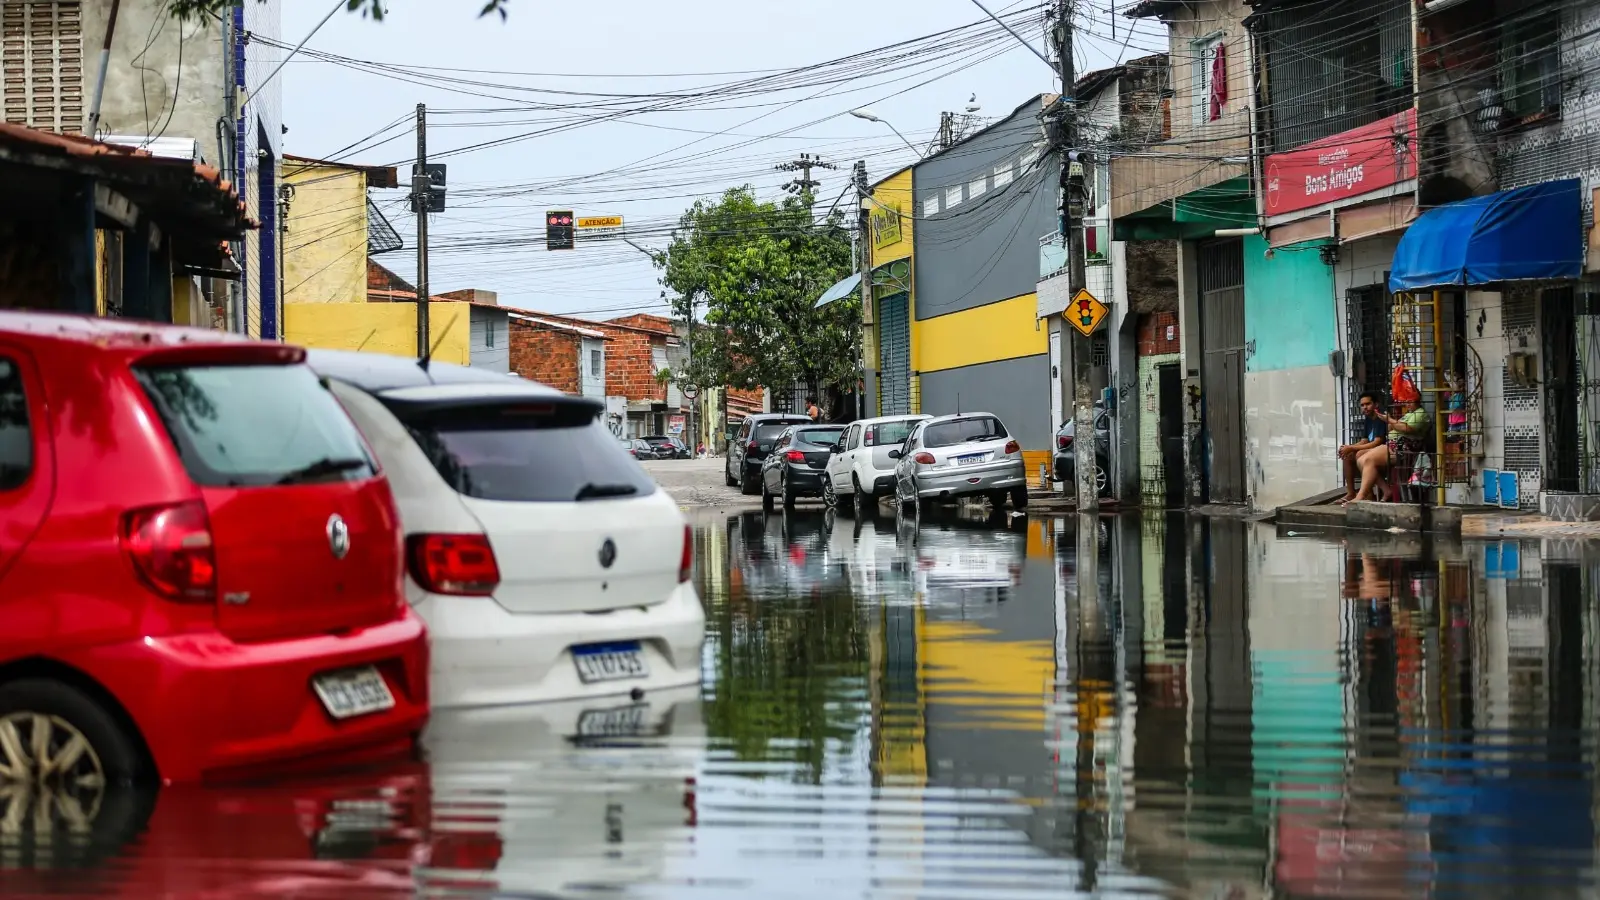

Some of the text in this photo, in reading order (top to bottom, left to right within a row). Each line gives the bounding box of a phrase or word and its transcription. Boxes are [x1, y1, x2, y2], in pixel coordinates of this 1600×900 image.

[1305, 175, 1327, 196] Bons
[1329, 163, 1363, 190] Amigos
[584, 217, 616, 227] ATENÇÃO
